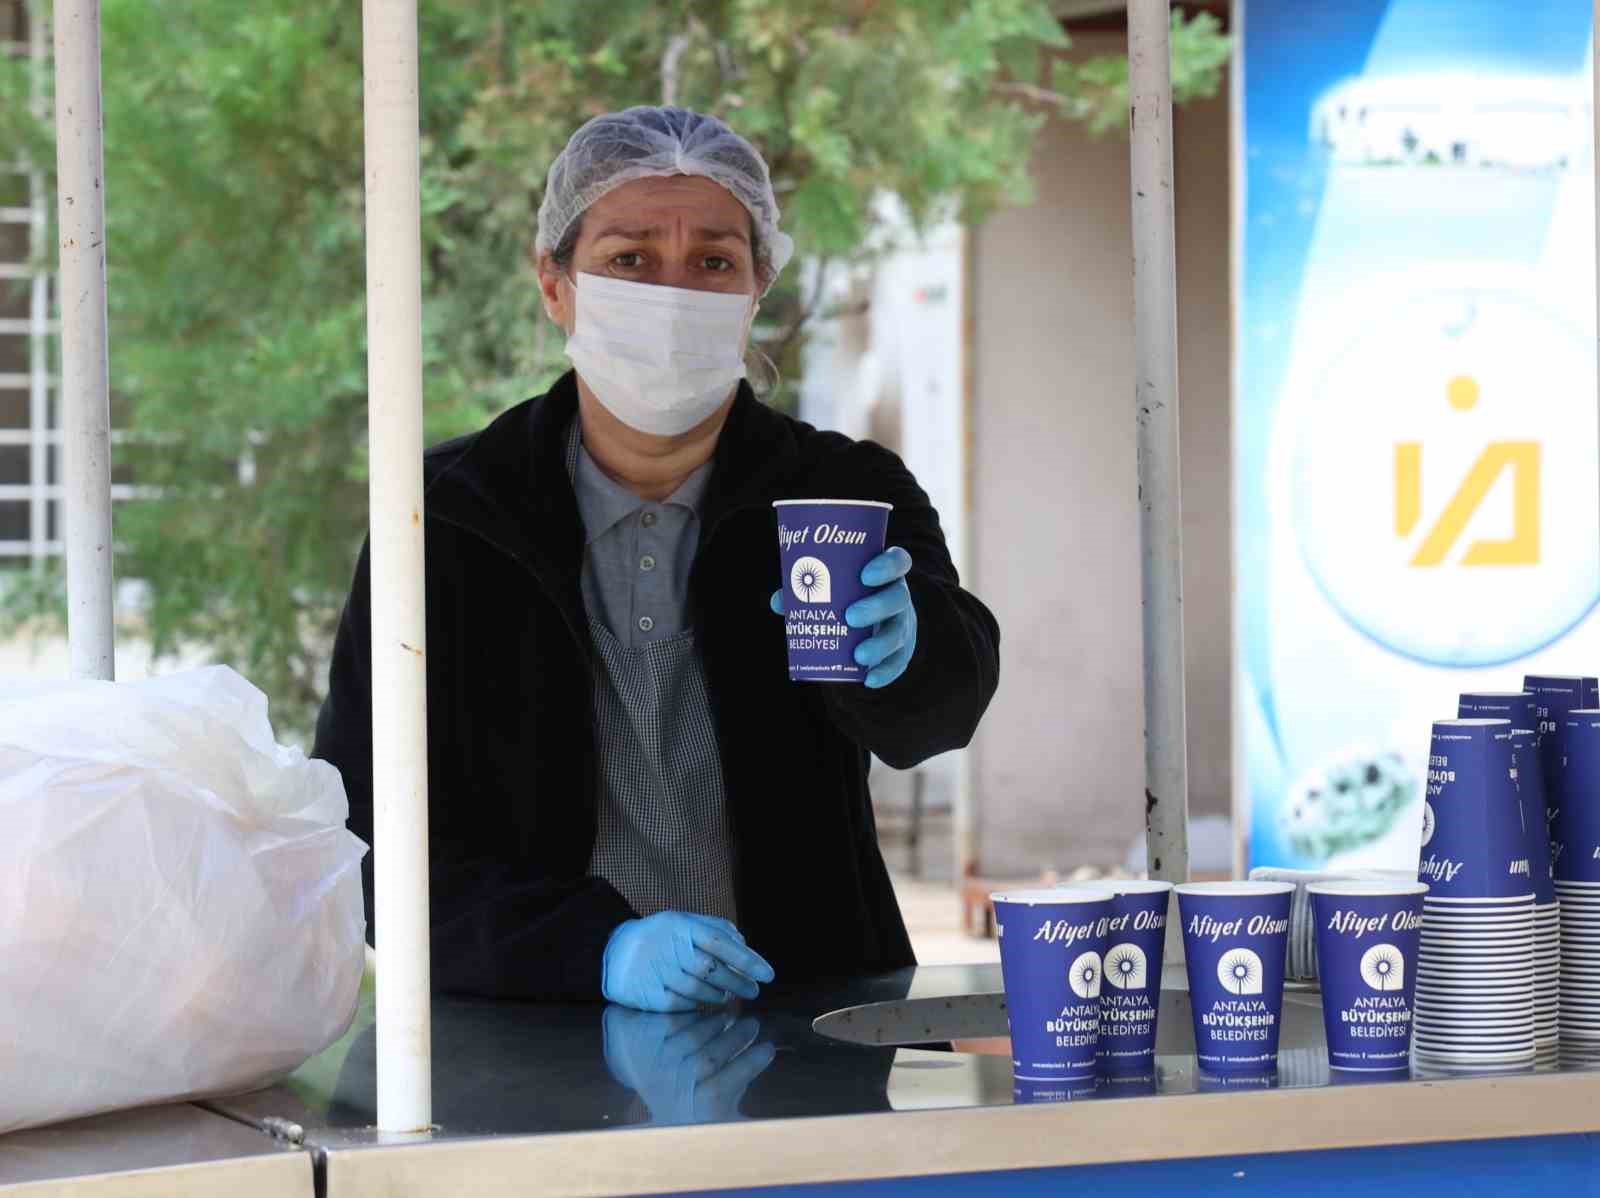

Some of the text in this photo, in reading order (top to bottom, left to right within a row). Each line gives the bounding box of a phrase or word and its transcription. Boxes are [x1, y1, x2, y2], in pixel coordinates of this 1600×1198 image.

[813, 523, 867, 545] Olsun
[789, 609, 836, 621] ANTALYA
[1188, 915, 1288, 943] Afiyet Olsun
[1328, 910, 1388, 939] Afiyet
[1033, 919, 1095, 948] Afiyet
[1213, 1000, 1266, 1012] ANTALYA
[1353, 996, 1406, 1008] ANTALYA
[1202, 1010, 1275, 1027] BÜYÜKŞEHİR
[1341, 1007, 1412, 1023] BÜYÜKŞEHİR
[1210, 1027, 1269, 1041] BELEDİYESİ
[1350, 1023, 1407, 1038] BELEDİYESİ
